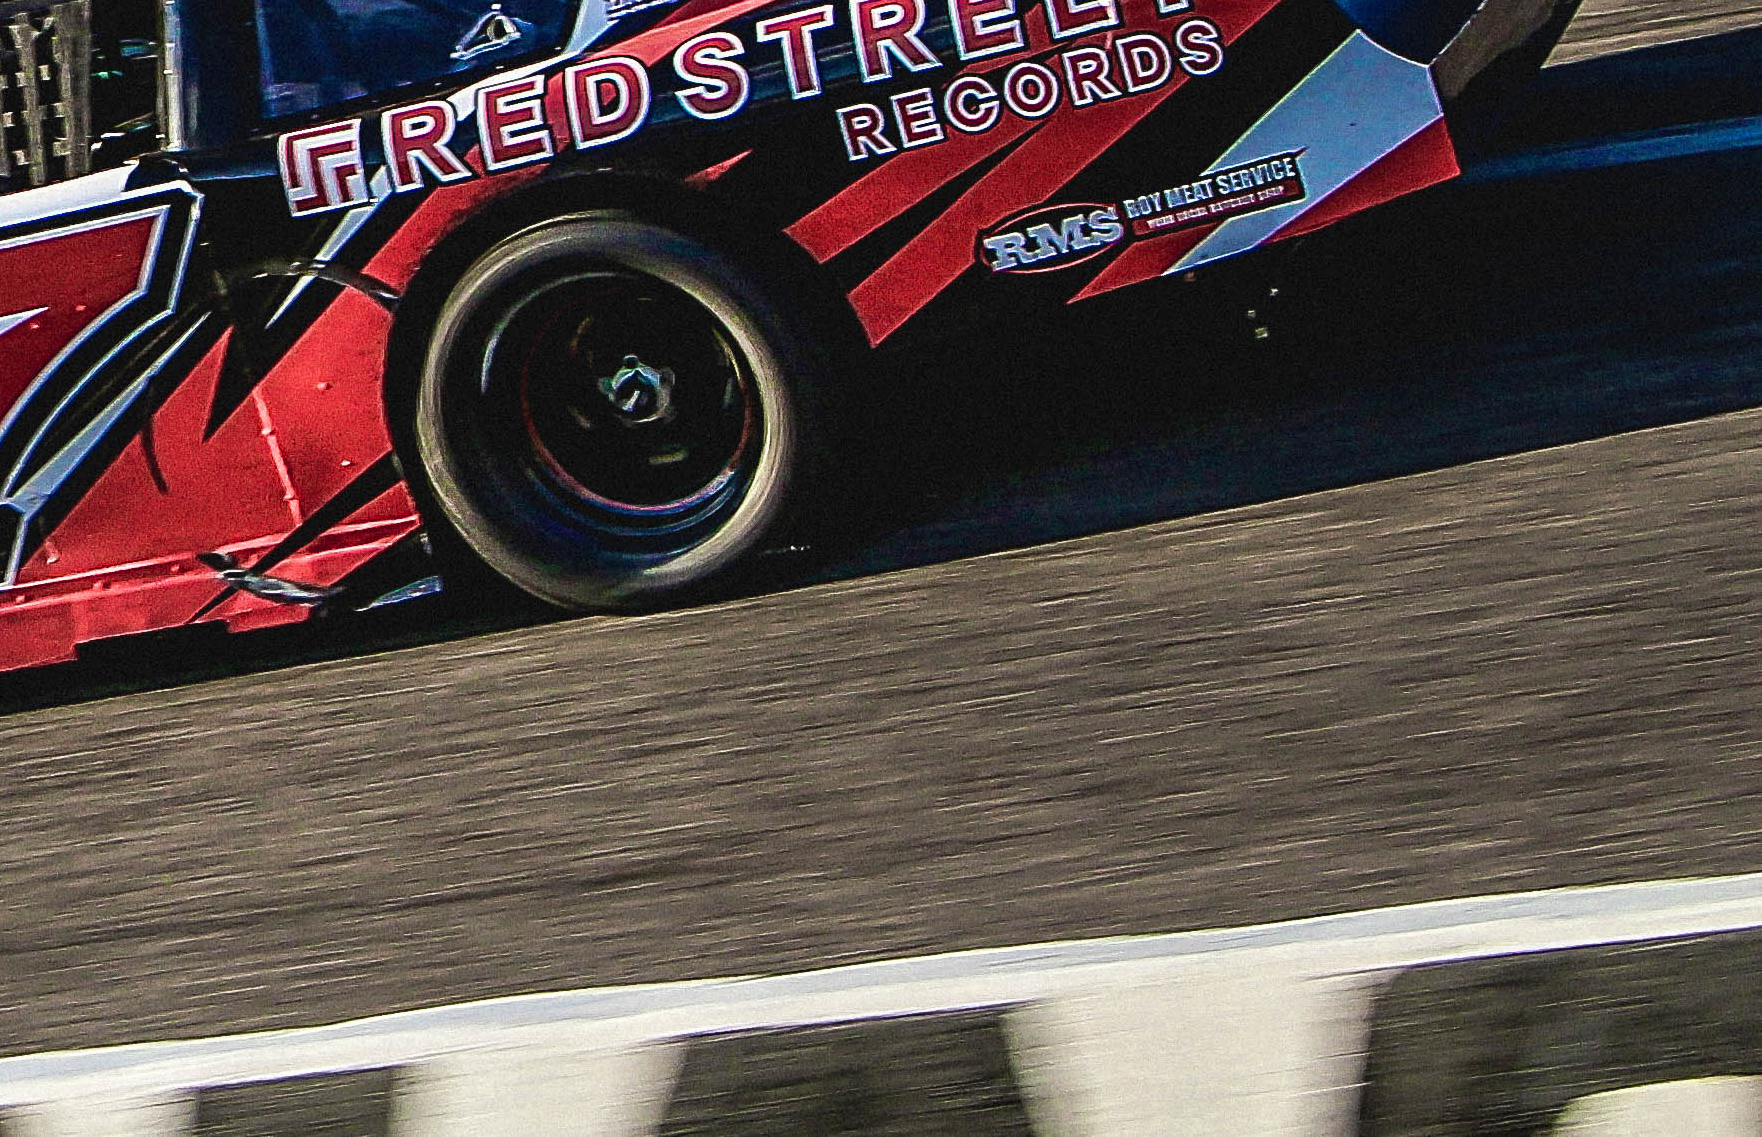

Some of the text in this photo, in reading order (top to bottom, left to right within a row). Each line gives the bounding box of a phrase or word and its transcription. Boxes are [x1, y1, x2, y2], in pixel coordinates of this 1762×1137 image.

[837, 19, 1226, 163] RECORDS
[1164, 178, 1215, 209] MEAT
[1216, 157, 1297, 195] SERVICE
[982, 206, 1125, 273] RMS
